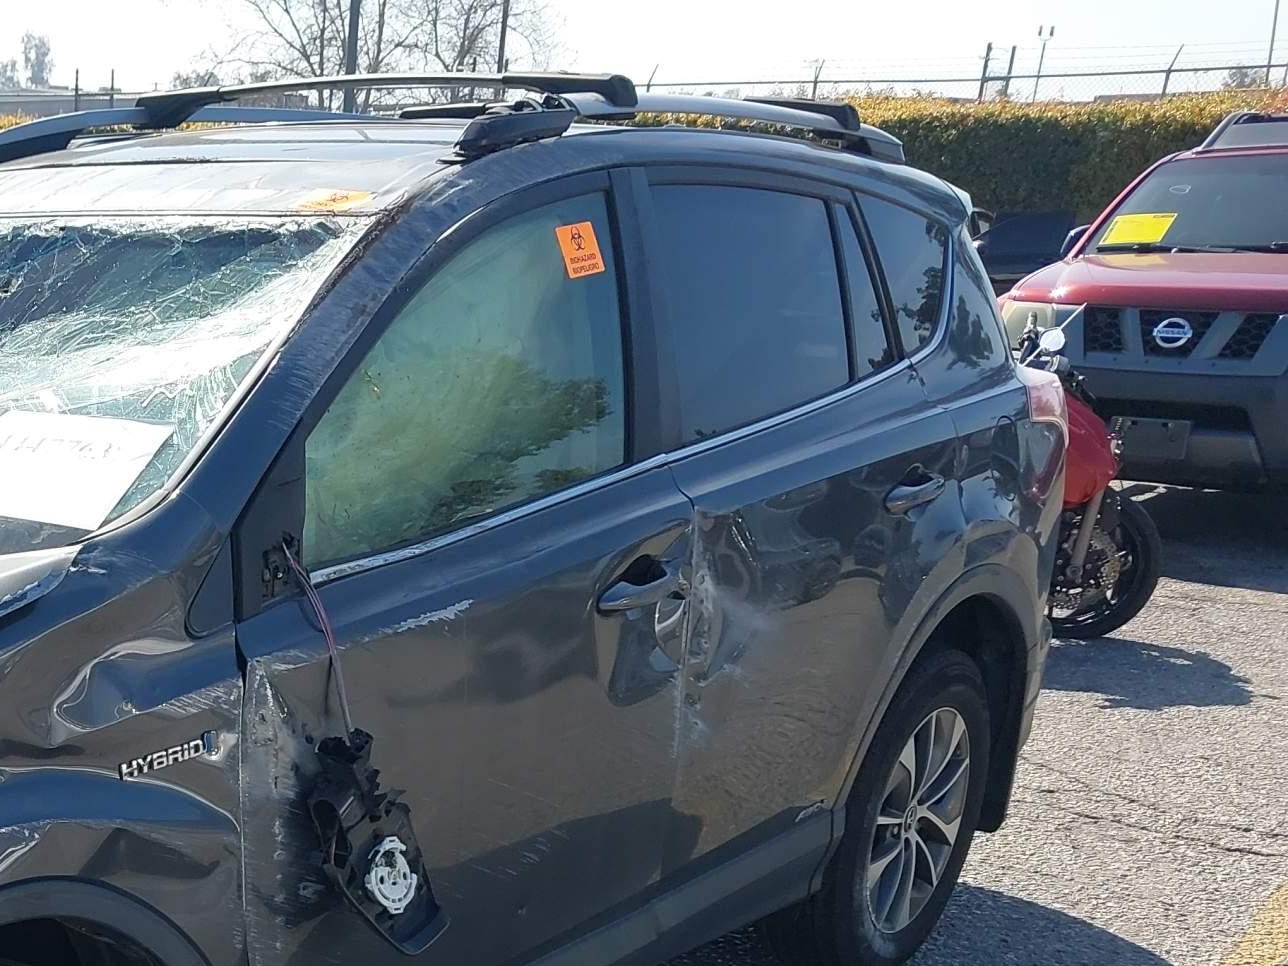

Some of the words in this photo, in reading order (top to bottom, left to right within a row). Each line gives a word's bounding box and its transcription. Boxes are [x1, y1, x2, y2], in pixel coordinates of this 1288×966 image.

[570, 252, 597, 265] BIOHAZARD
[1155, 325, 1188, 337] NISSAN
[119, 738, 204, 781] HYBRID
